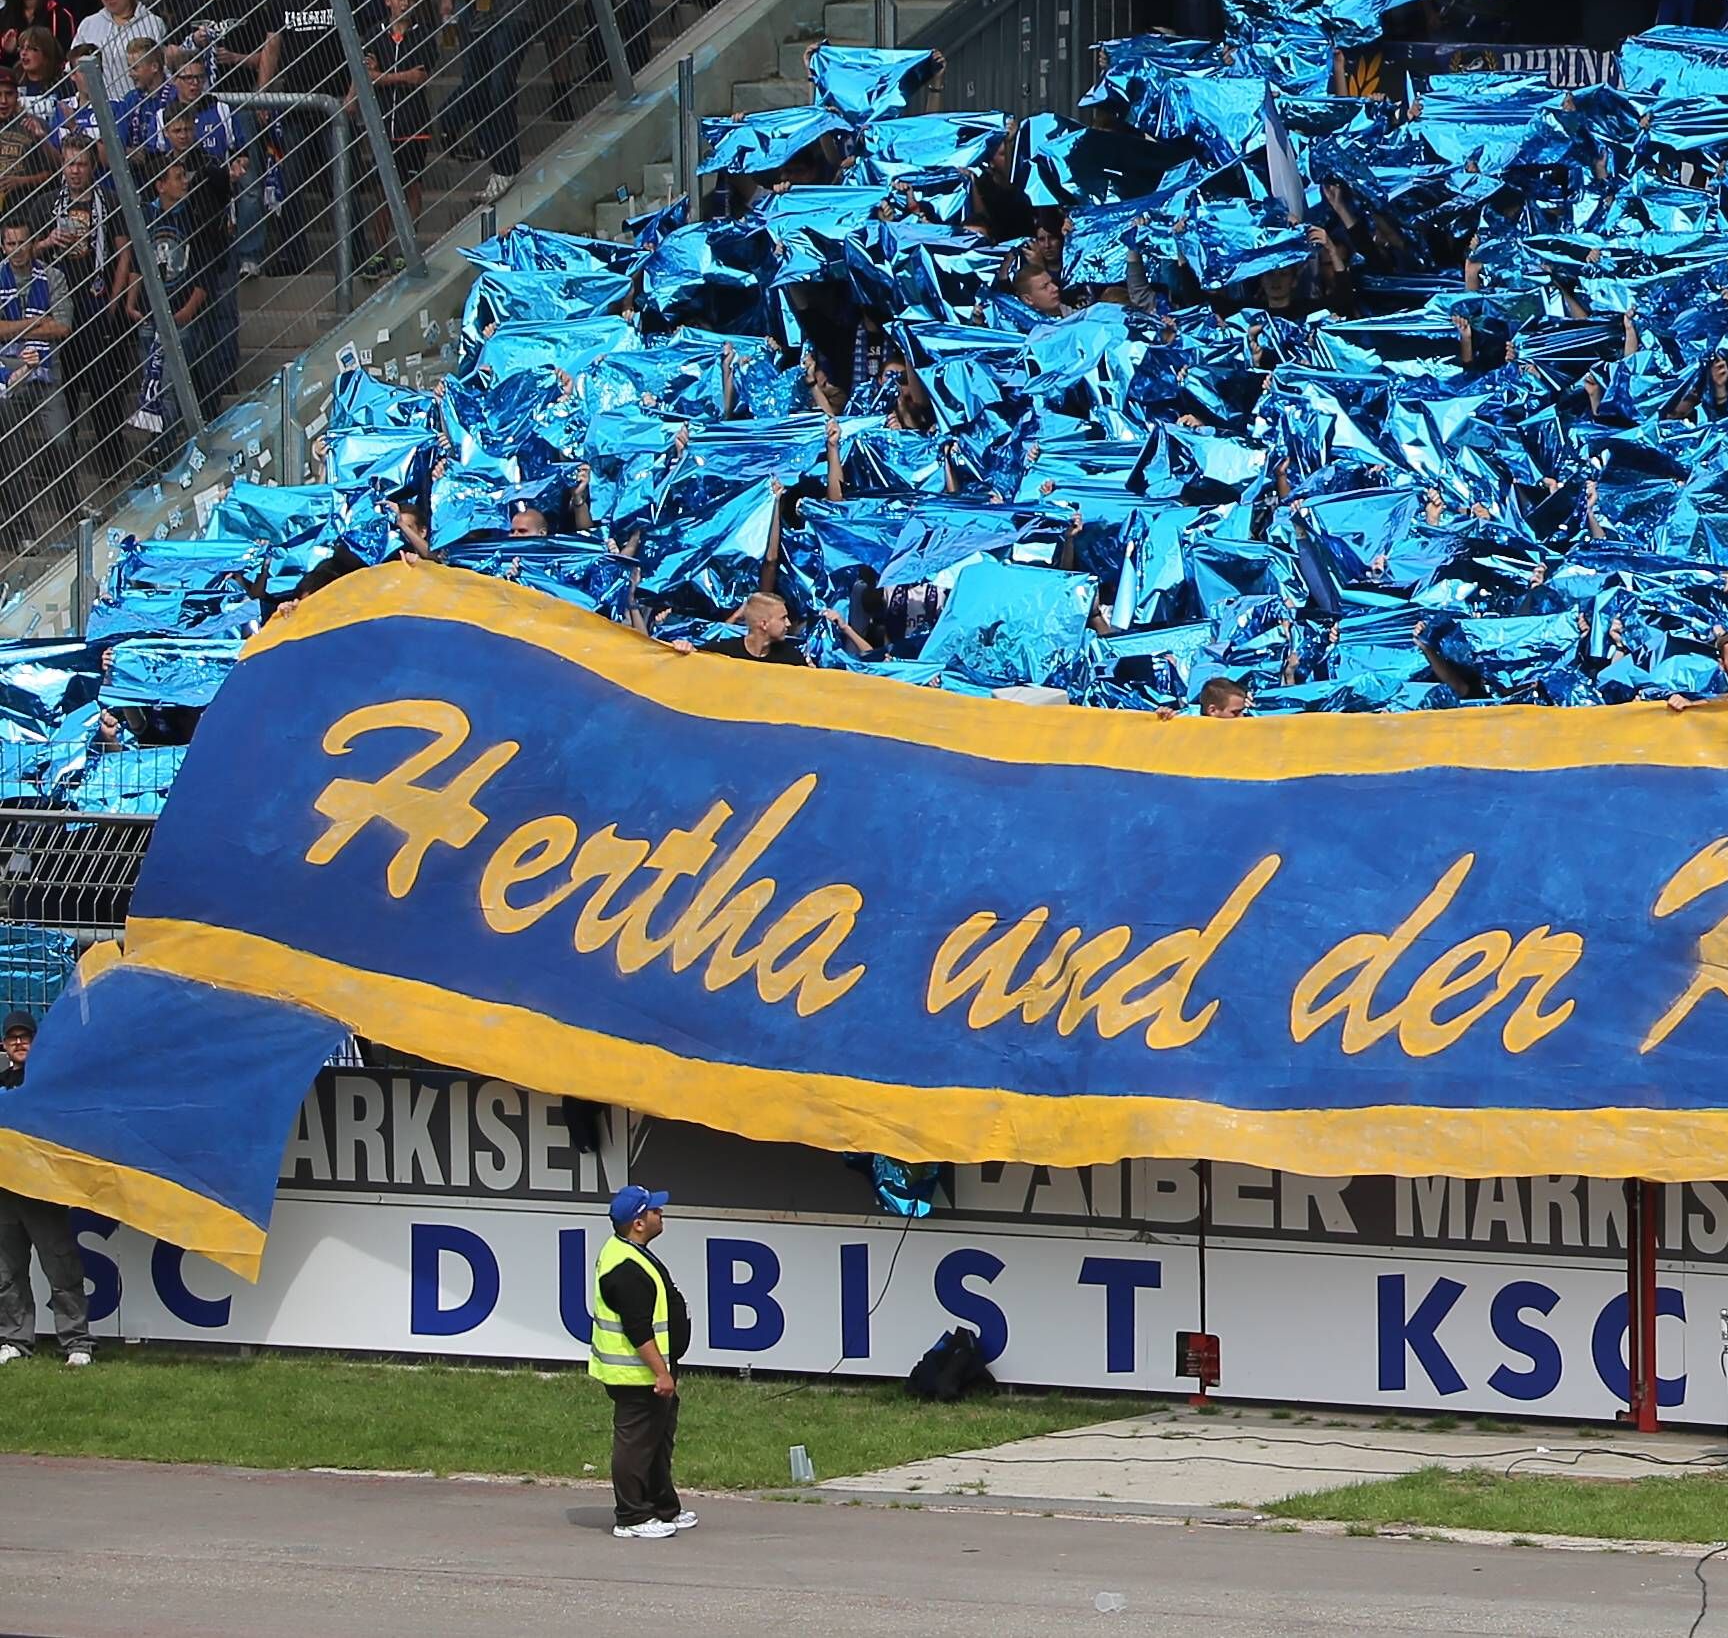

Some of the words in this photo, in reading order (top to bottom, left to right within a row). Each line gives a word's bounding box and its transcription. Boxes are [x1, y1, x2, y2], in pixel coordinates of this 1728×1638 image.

[304, 698, 868, 1018] Hertha
[926, 852, 1281, 1050] und
[1290, 852, 1584, 1059] der
[1377, 1273, 1687, 1408] KSC
